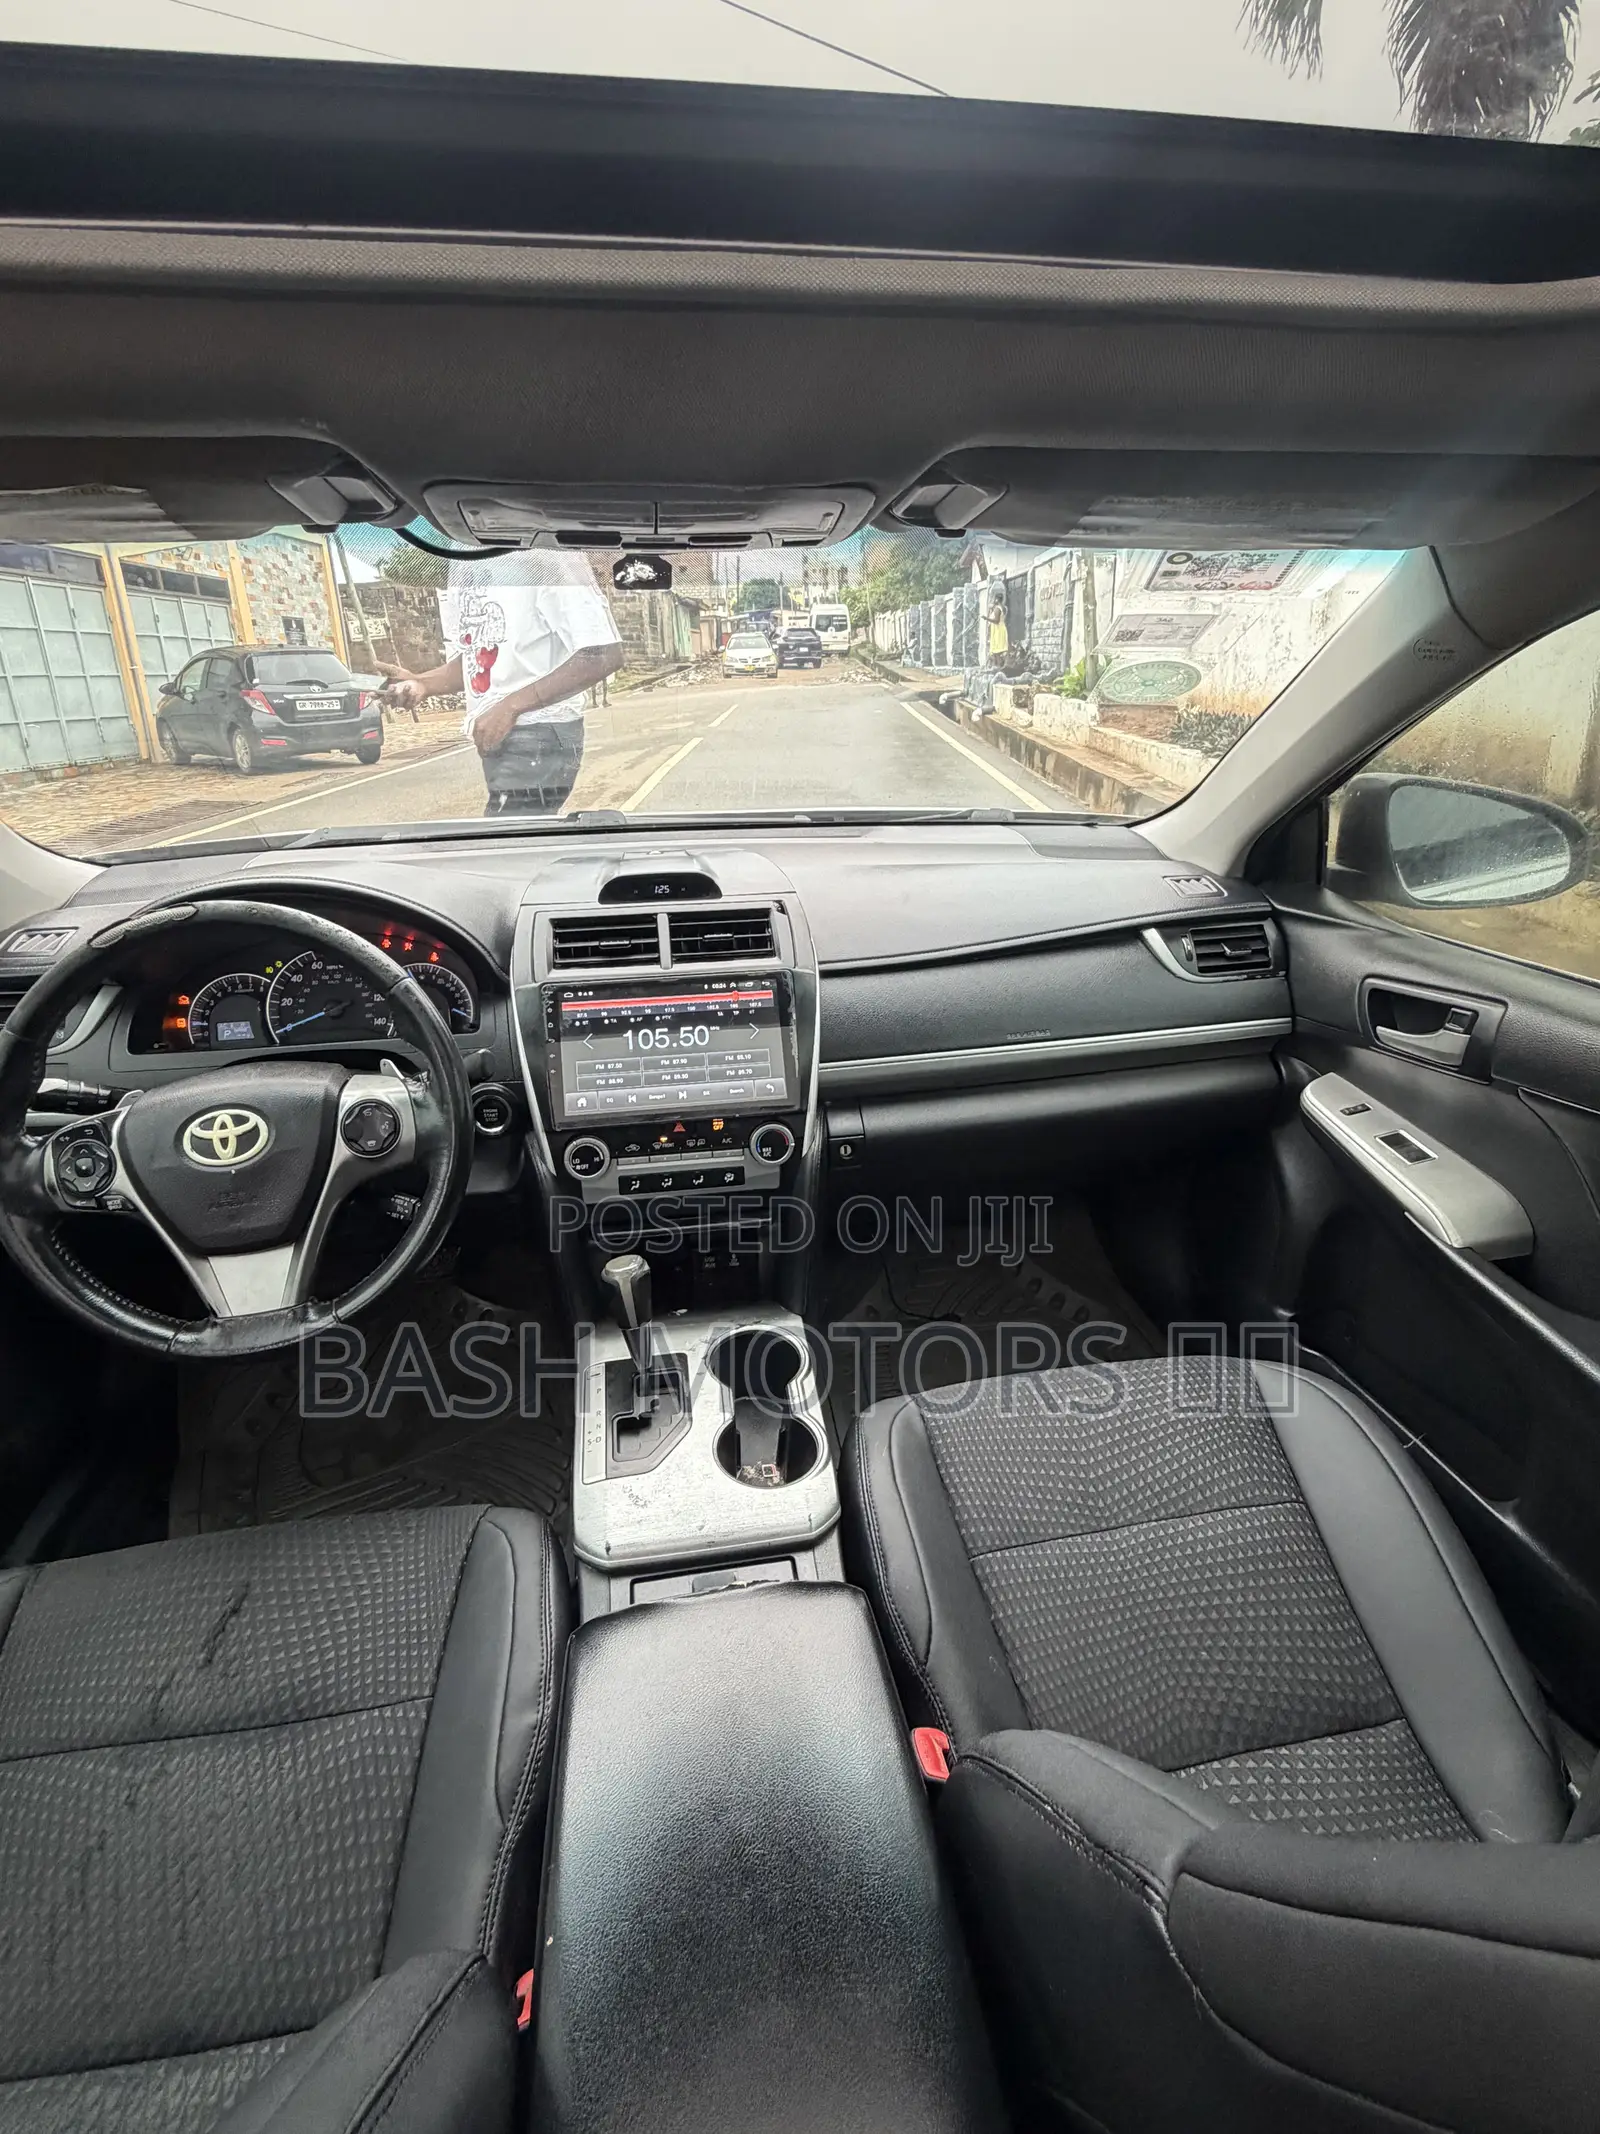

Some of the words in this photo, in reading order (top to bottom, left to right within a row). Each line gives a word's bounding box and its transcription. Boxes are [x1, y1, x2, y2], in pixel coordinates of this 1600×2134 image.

[311, 961, 323, 970] 60
[291, 974, 303, 983] 40
[281, 998, 293, 1006] 20
[373, 994, 385, 1002] 12
[373, 1017, 387, 1025] 140
[622, 1025, 710, 1050] 105.50
